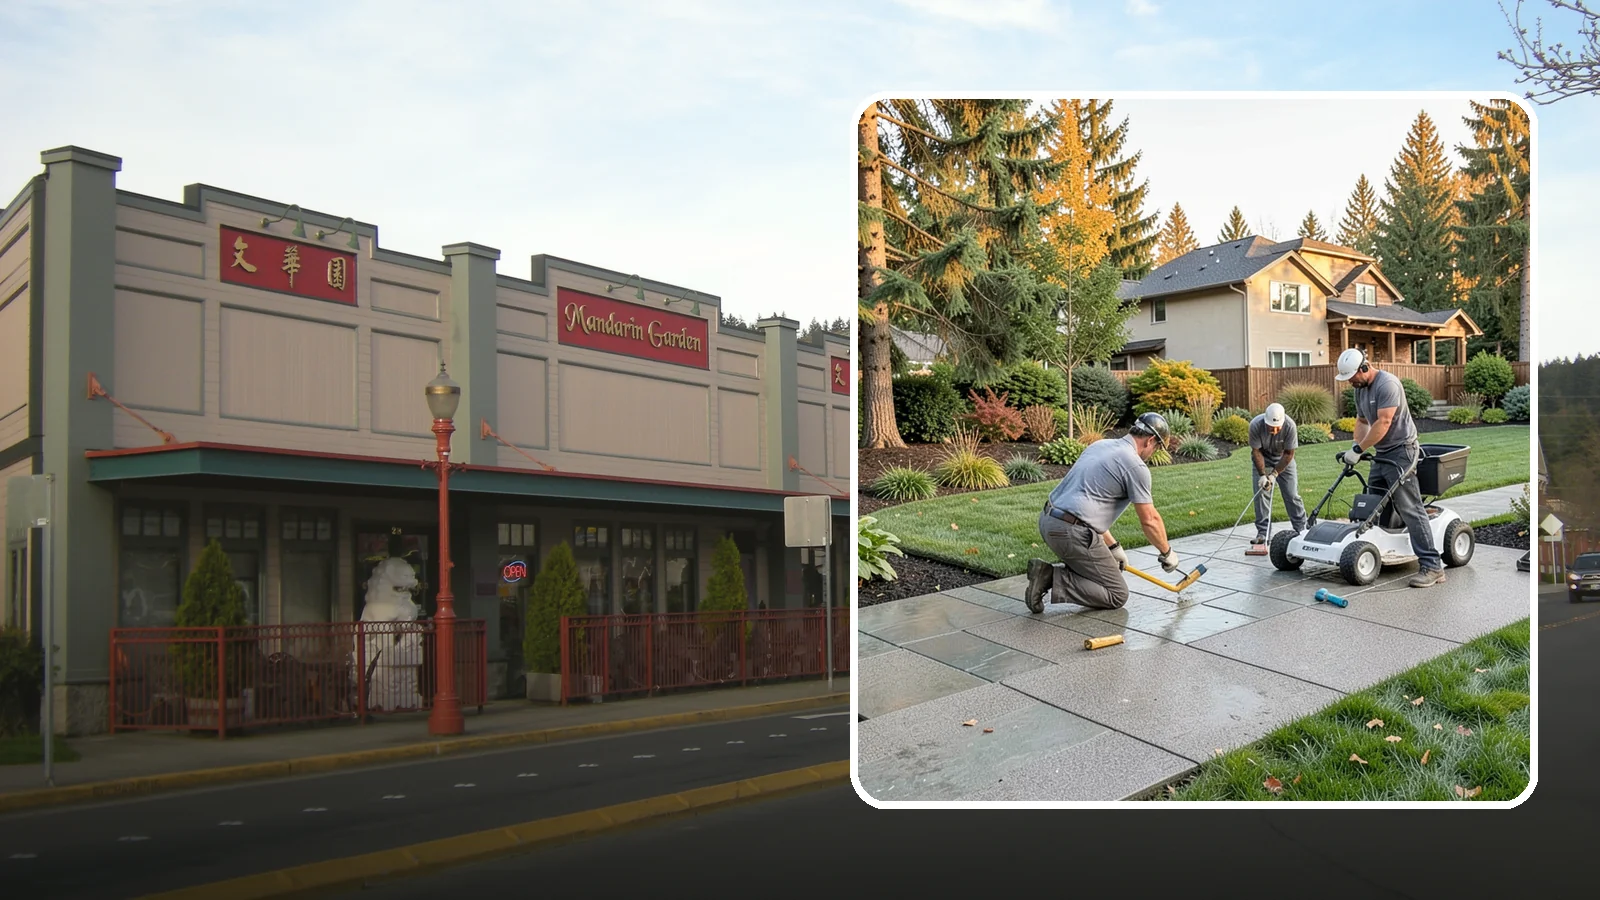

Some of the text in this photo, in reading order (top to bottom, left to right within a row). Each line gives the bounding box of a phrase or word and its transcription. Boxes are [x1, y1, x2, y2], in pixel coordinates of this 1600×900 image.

[231, 236, 346, 291] 文華園
[564, 302, 702, 352] Mandarin Garden
[503, 565, 527, 578] OPEN
